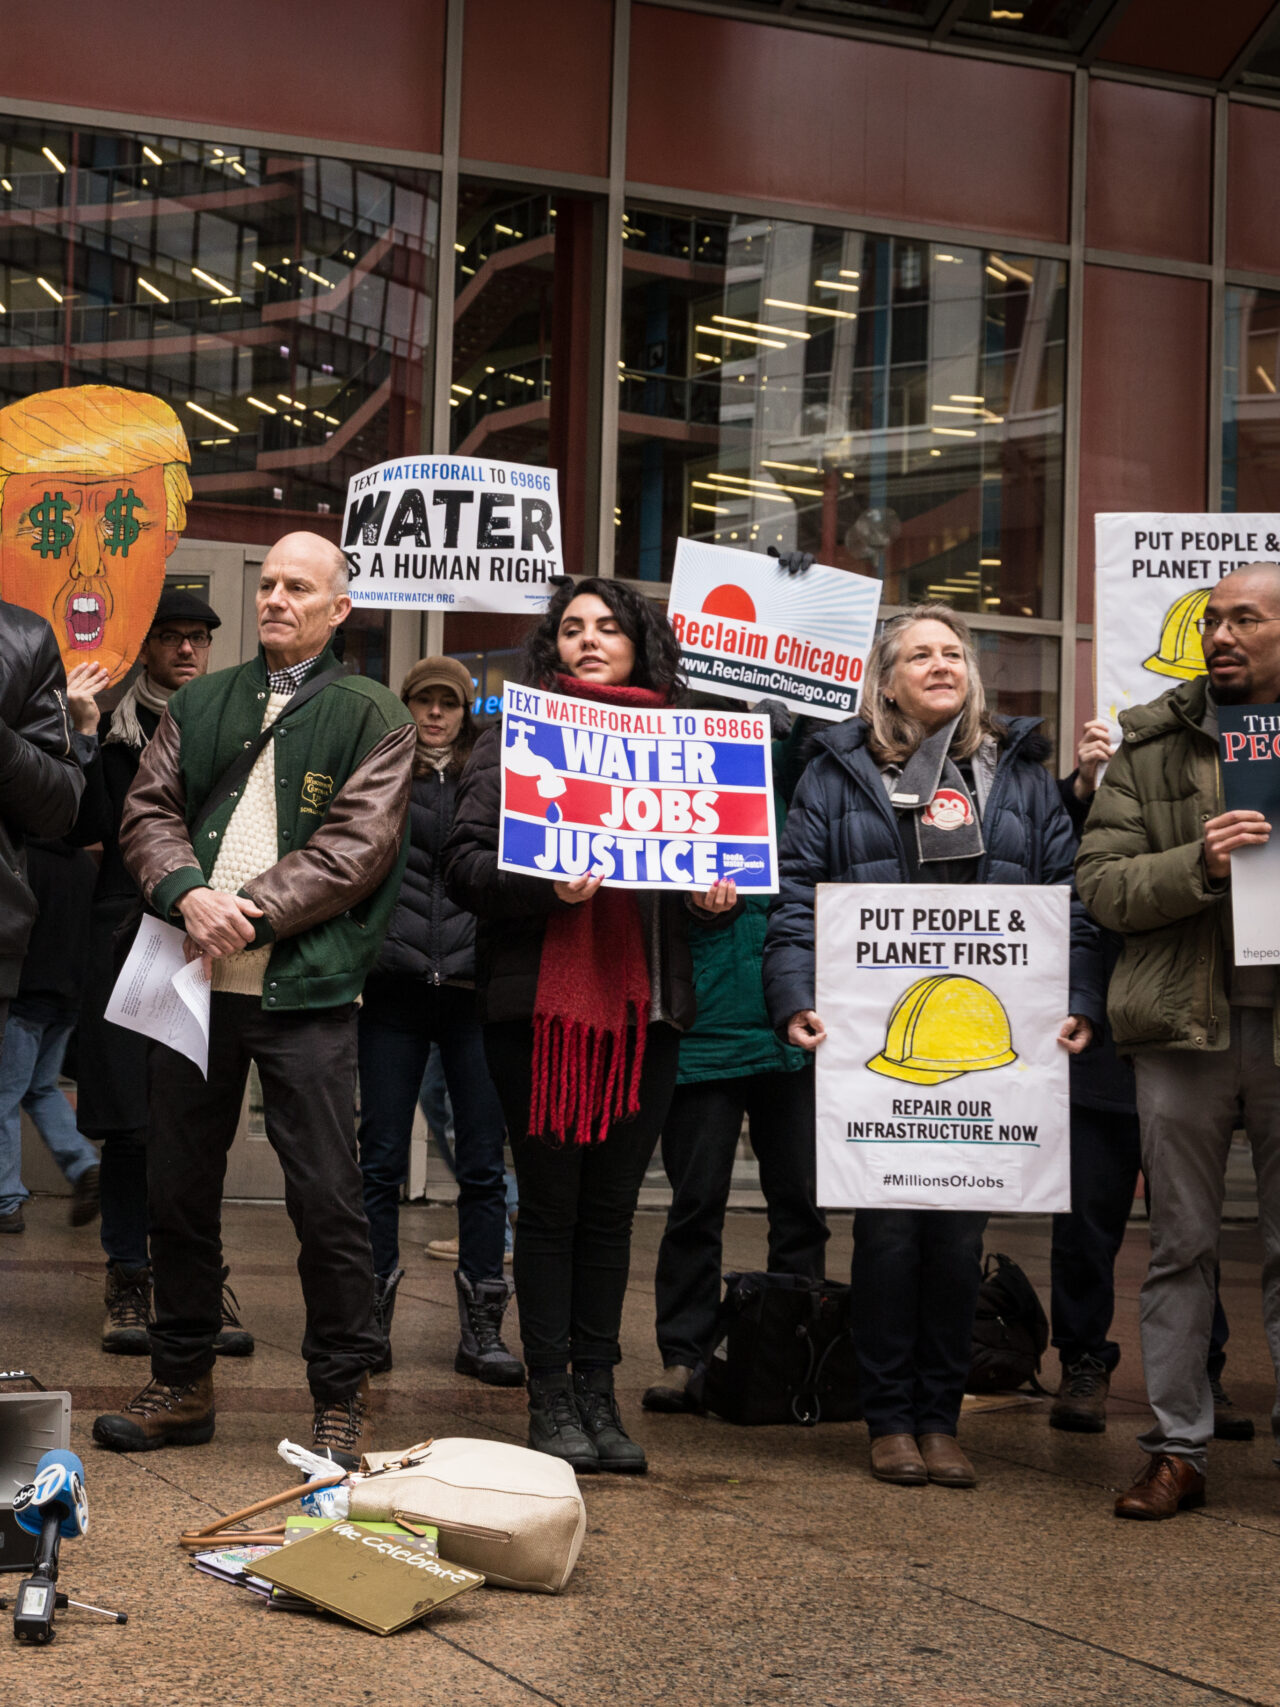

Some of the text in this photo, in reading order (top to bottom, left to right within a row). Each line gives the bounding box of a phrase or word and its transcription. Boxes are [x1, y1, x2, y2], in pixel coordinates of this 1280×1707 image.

[353, 463, 551, 493] TEXT WATERFORALL TO 69866
[344, 489, 555, 553] WATER
[1134, 531, 1280, 552] PUT PEOPLE &
[370, 553, 384, 577] A
[394, 554, 480, 581] HUMAN
[1132, 560, 1211, 579] PLANET
[673, 612, 864, 682] Reclaim Chicago
[508, 689, 540, 715] TEXT
[546, 698, 666, 734] WATERFORALL
[672, 716, 696, 735] TO
[704, 718, 764, 739] 69866
[561, 727, 718, 784] WATER
[600, 786, 720, 834] JOBS
[534, 827, 719, 884] JUSTICE
[860, 908, 1026, 932] PUT PEOPLE &
[856, 942, 1028, 966] PLANET FIRST!
[892, 1099, 991, 1116] REPAIR OUR
[847, 1121, 1038, 1142] INFRASTRUCTURE NOW
[883, 1174, 1004, 1188] #MillionsOfJobs
[13, 1488, 35, 1505] abc
